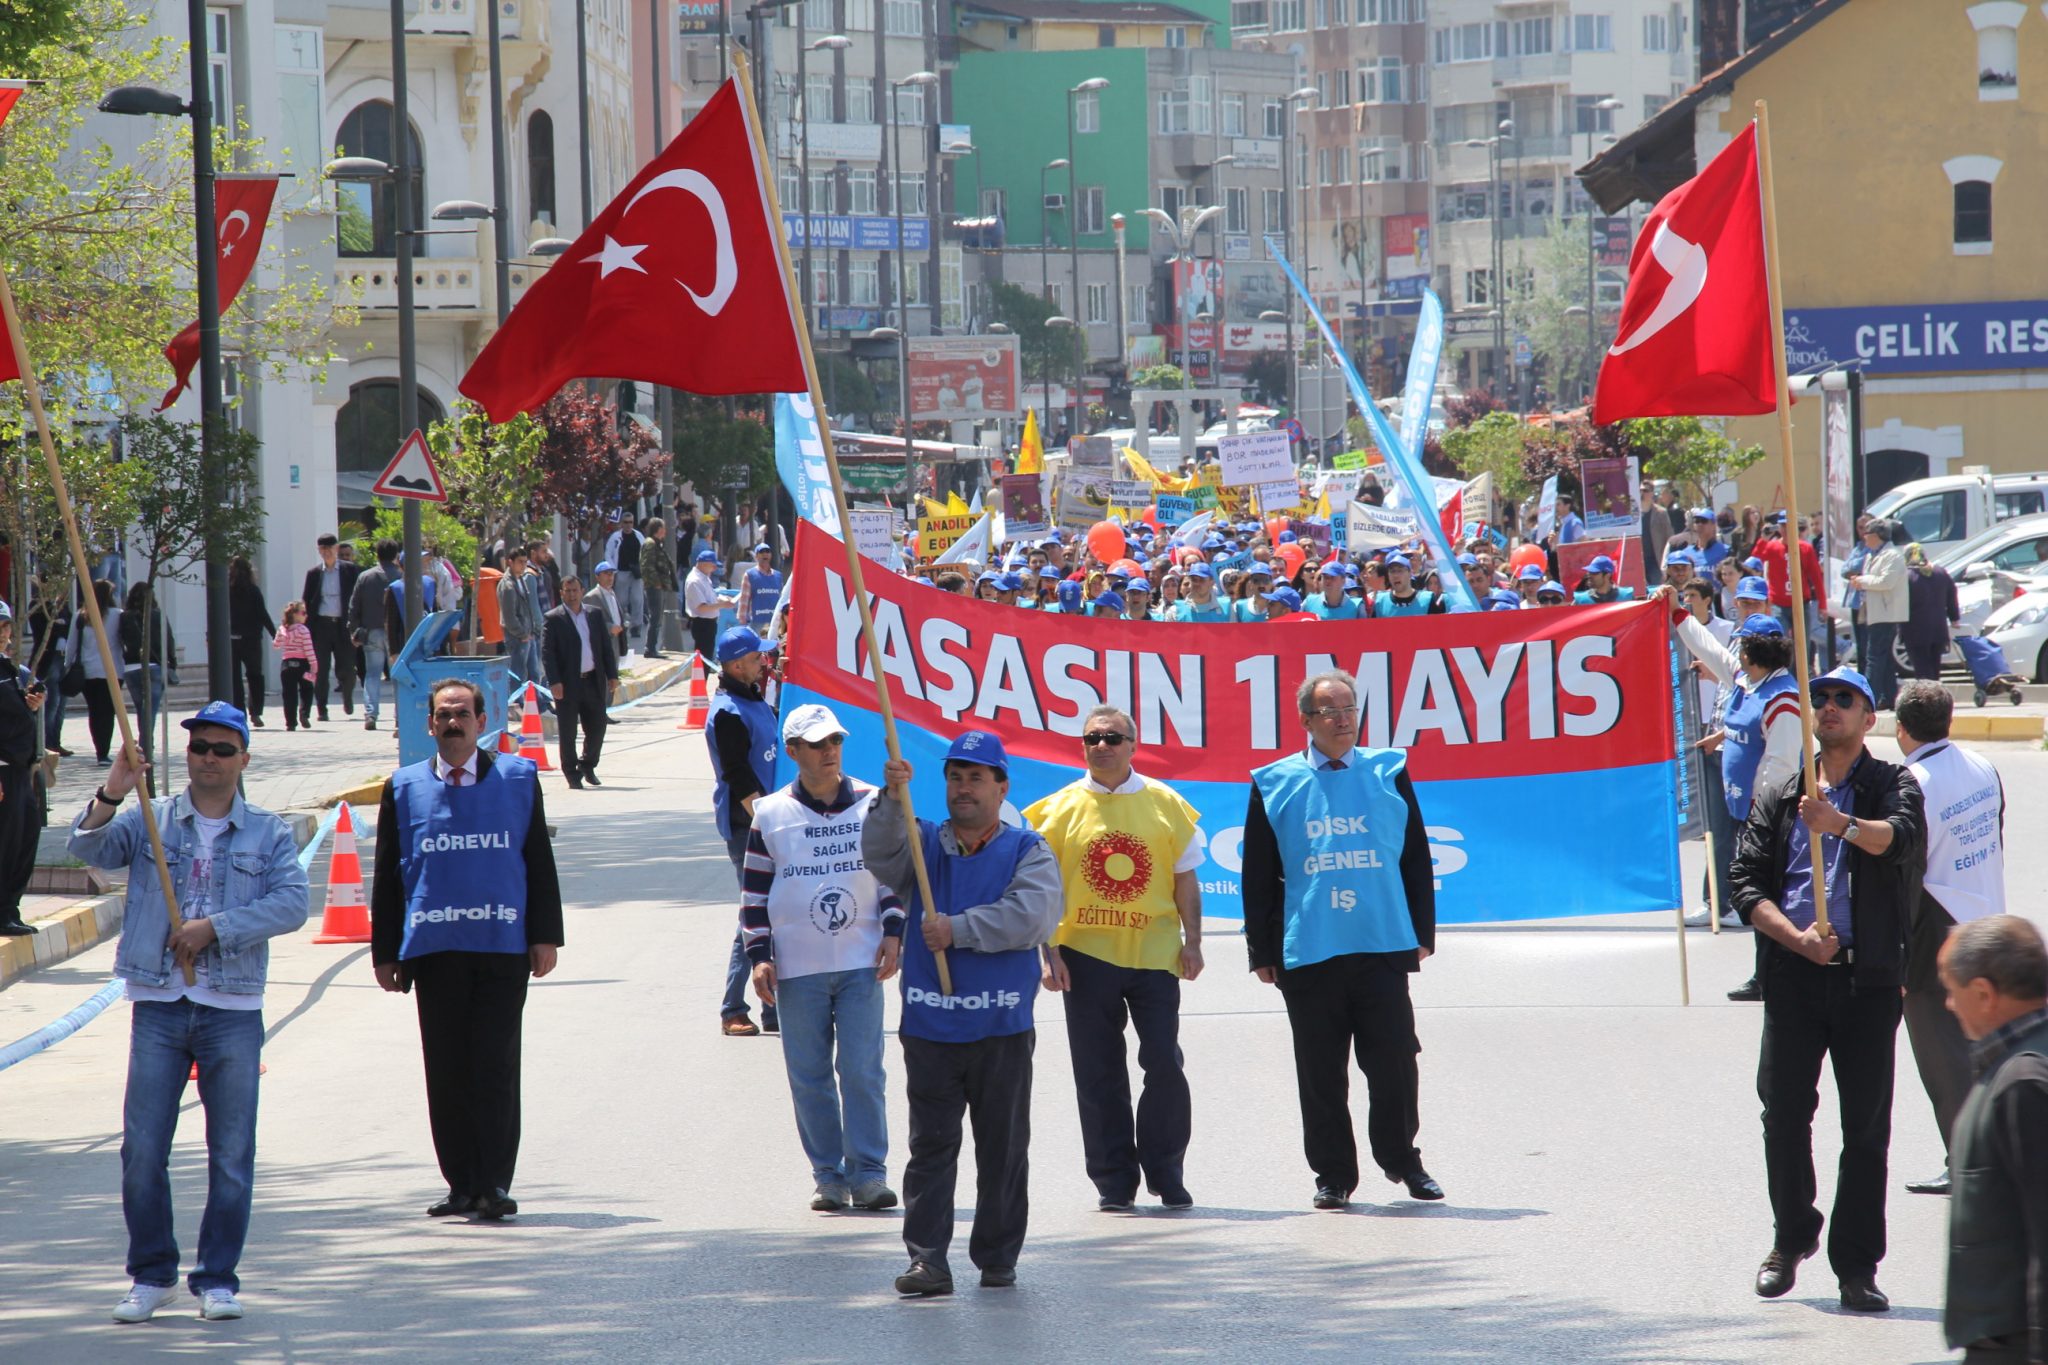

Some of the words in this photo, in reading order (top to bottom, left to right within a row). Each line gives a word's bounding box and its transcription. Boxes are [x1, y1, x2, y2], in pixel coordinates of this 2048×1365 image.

[795, 219, 849, 239] OAMAN
[1855, 313, 1960, 364] ÇELİK
[824, 566, 1207, 748] YAŞASIN
[1235, 654, 1281, 749] 1
[1304, 635, 1625, 749] MAYIS
[805, 822, 861, 839] HERKESE
[1306, 815, 1368, 839] DİSK
[421, 831, 510, 853] GÖREVLİ
[813, 840, 858, 857] SAĞLIK
[783, 862, 830, 879] GÜVENLİ
[1303, 849, 1382, 875] GENEL
[1330, 886, 1357, 912] İŞ
[410, 904, 518, 928] petrol-iş
[1077, 905, 1126, 927] EĞİTİM
[1130, 911, 1153, 930] SEN
[906, 986, 1021, 1010] petrol-iş
